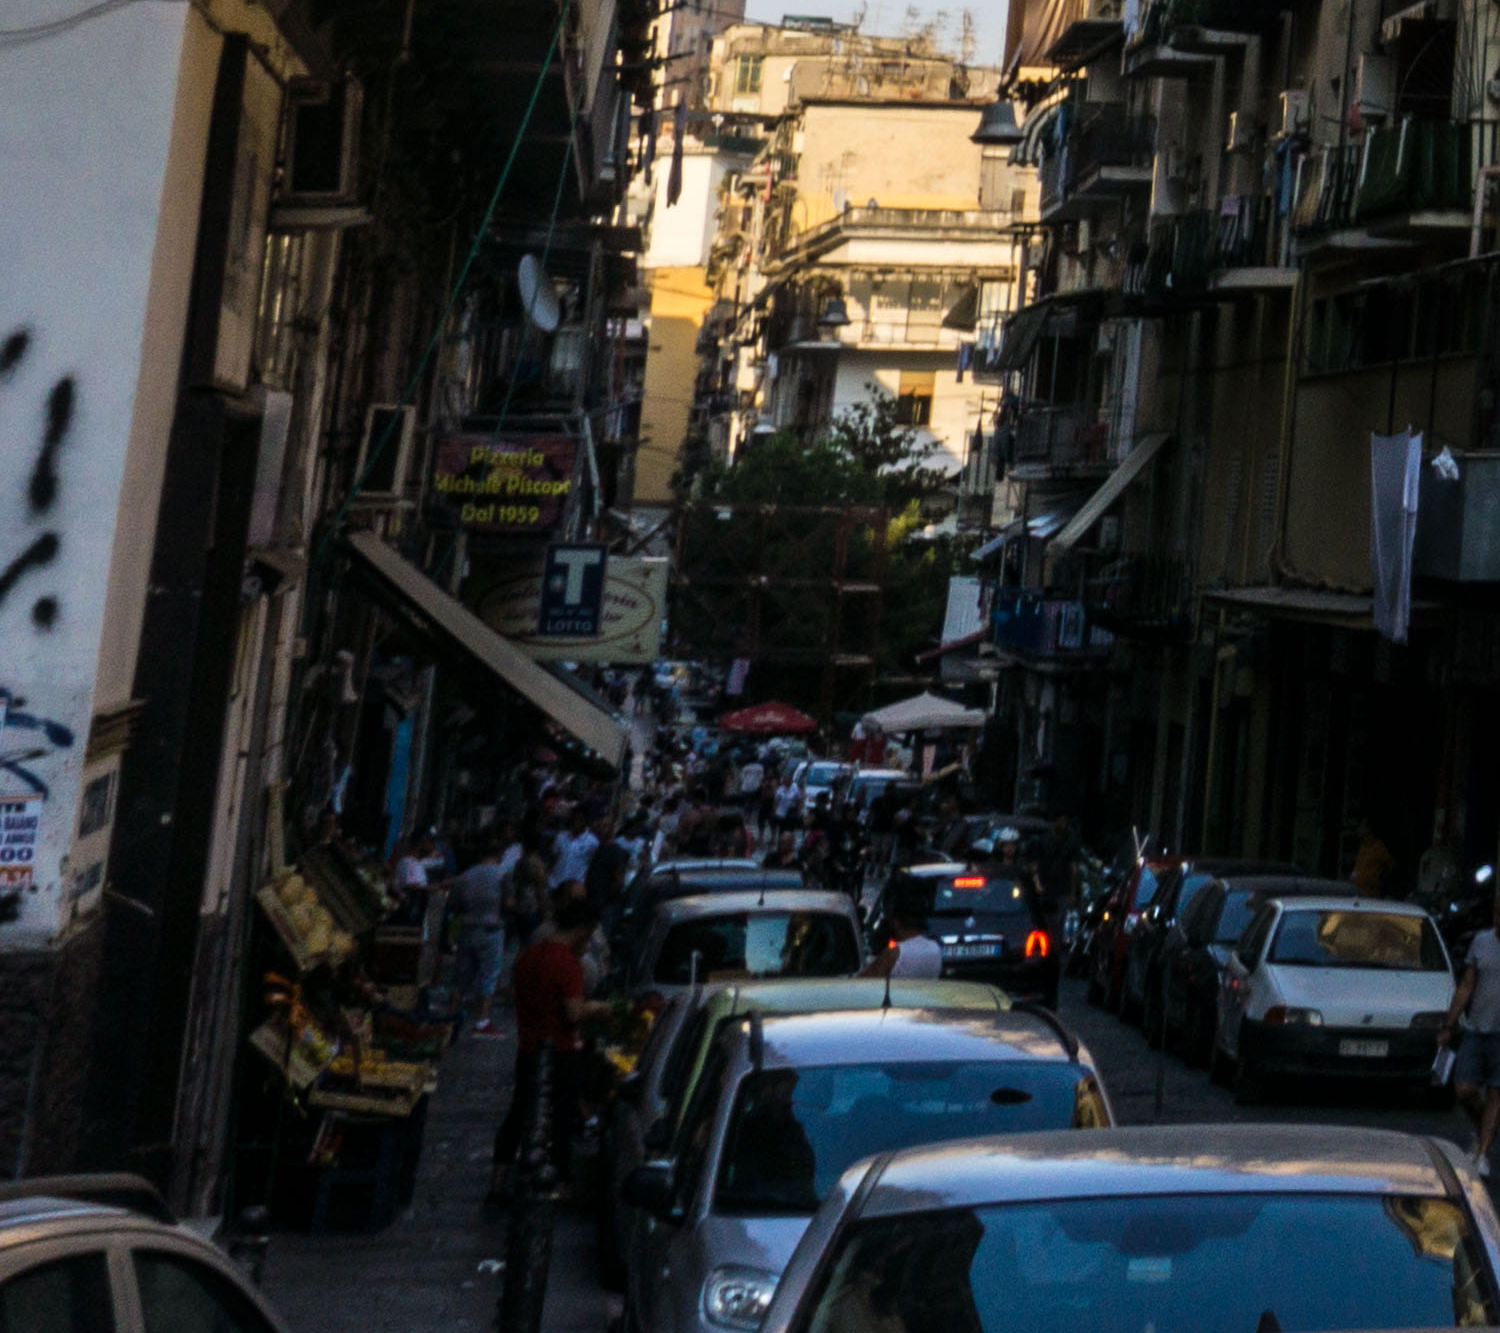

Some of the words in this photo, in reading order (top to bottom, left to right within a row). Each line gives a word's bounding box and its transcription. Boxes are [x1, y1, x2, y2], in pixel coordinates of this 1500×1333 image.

[470, 445, 545, 467] Pizzeria
[461, 503, 495, 523] Dal
[499, 504, 541, 524] 1959
[554, 548, 601, 606] T
[546, 620, 594, 632] LOTTO
